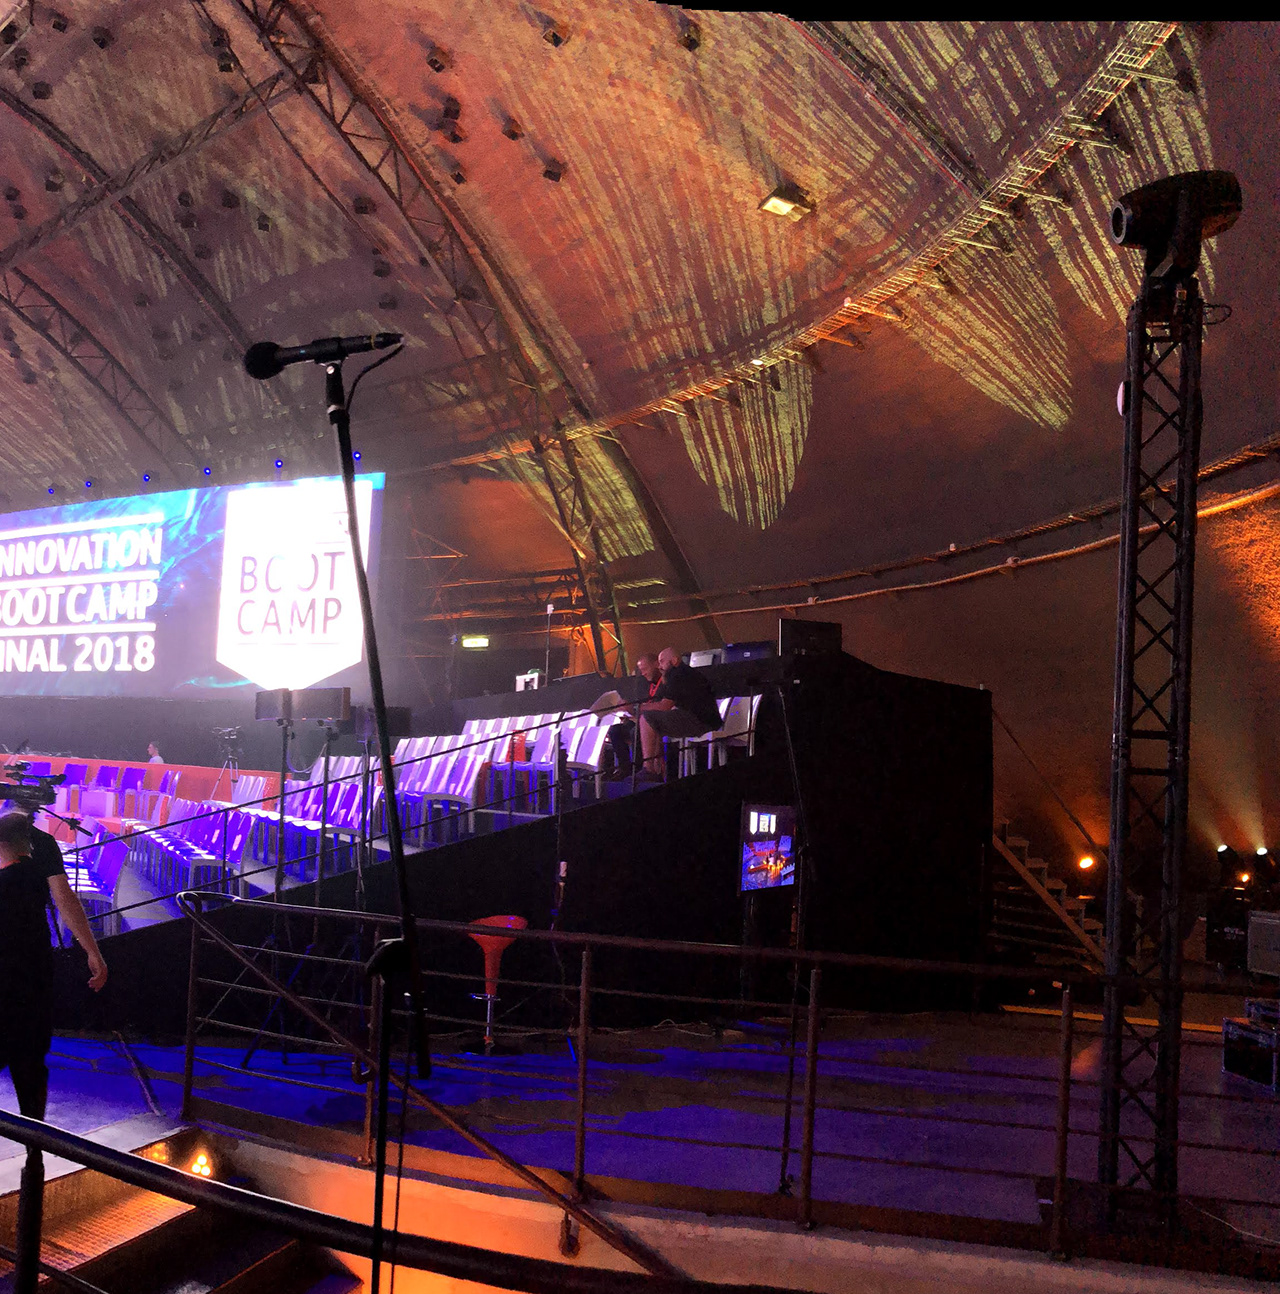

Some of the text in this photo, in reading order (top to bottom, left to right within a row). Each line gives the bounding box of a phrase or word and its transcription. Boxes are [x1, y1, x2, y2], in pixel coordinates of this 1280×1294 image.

[240, 551, 346, 594] BOOT
[237, 597, 342, 636] CAMP
[74, 635, 156, 672] 2018
